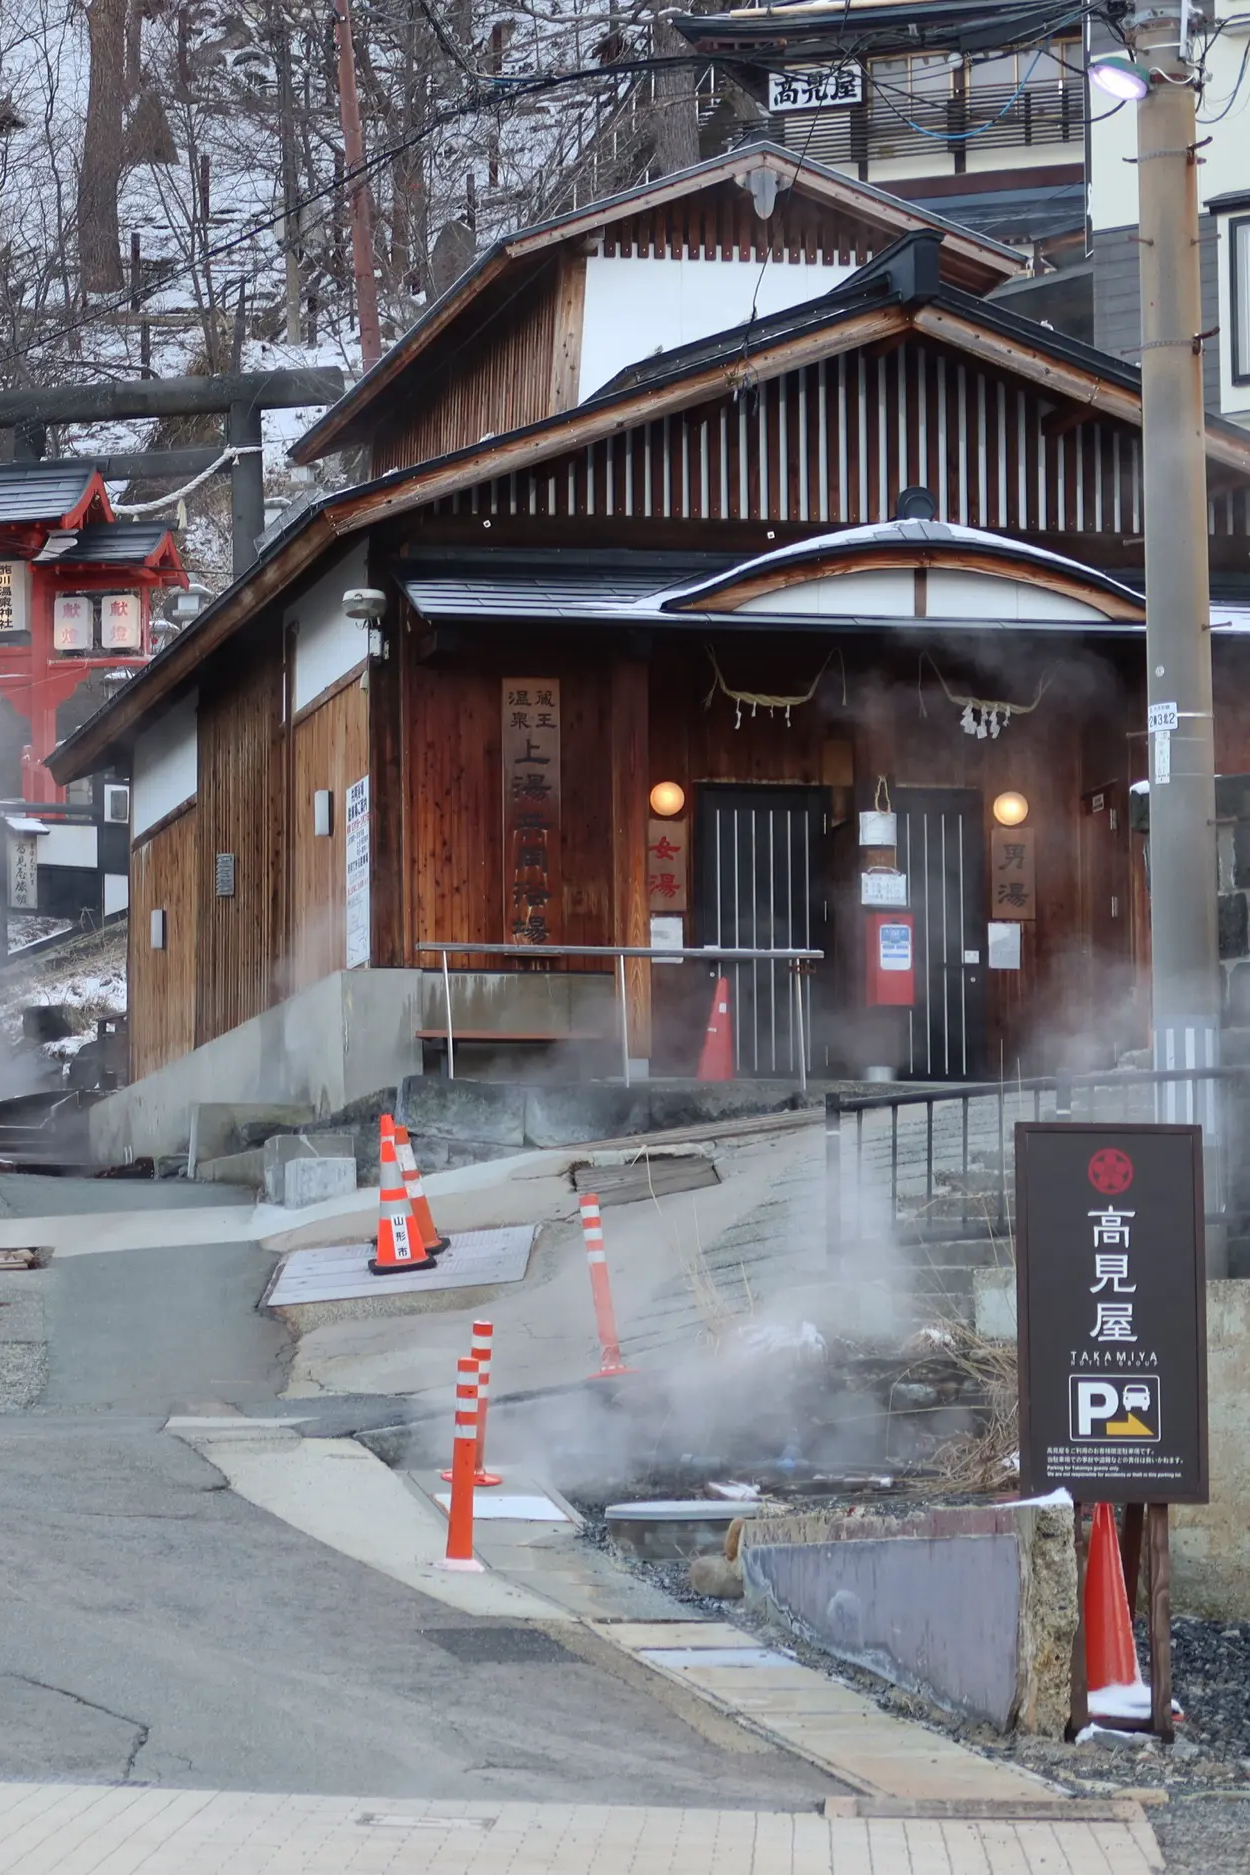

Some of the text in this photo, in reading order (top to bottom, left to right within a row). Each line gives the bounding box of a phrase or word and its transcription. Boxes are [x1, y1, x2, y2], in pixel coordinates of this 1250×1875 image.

[508, 690, 532, 730] 温泉
[512, 738, 553, 944] 上湯共同浴場
[649, 836, 681, 898] 女湯
[997, 844, 1029, 907] 男湯
[394, 1216, 408, 1256] 山形市
[1088, 1205, 1138, 1342] 高見屋
[1070, 1351, 1158, 1361] TAKAMIYA
[1078, 1382, 1119, 1435] P
